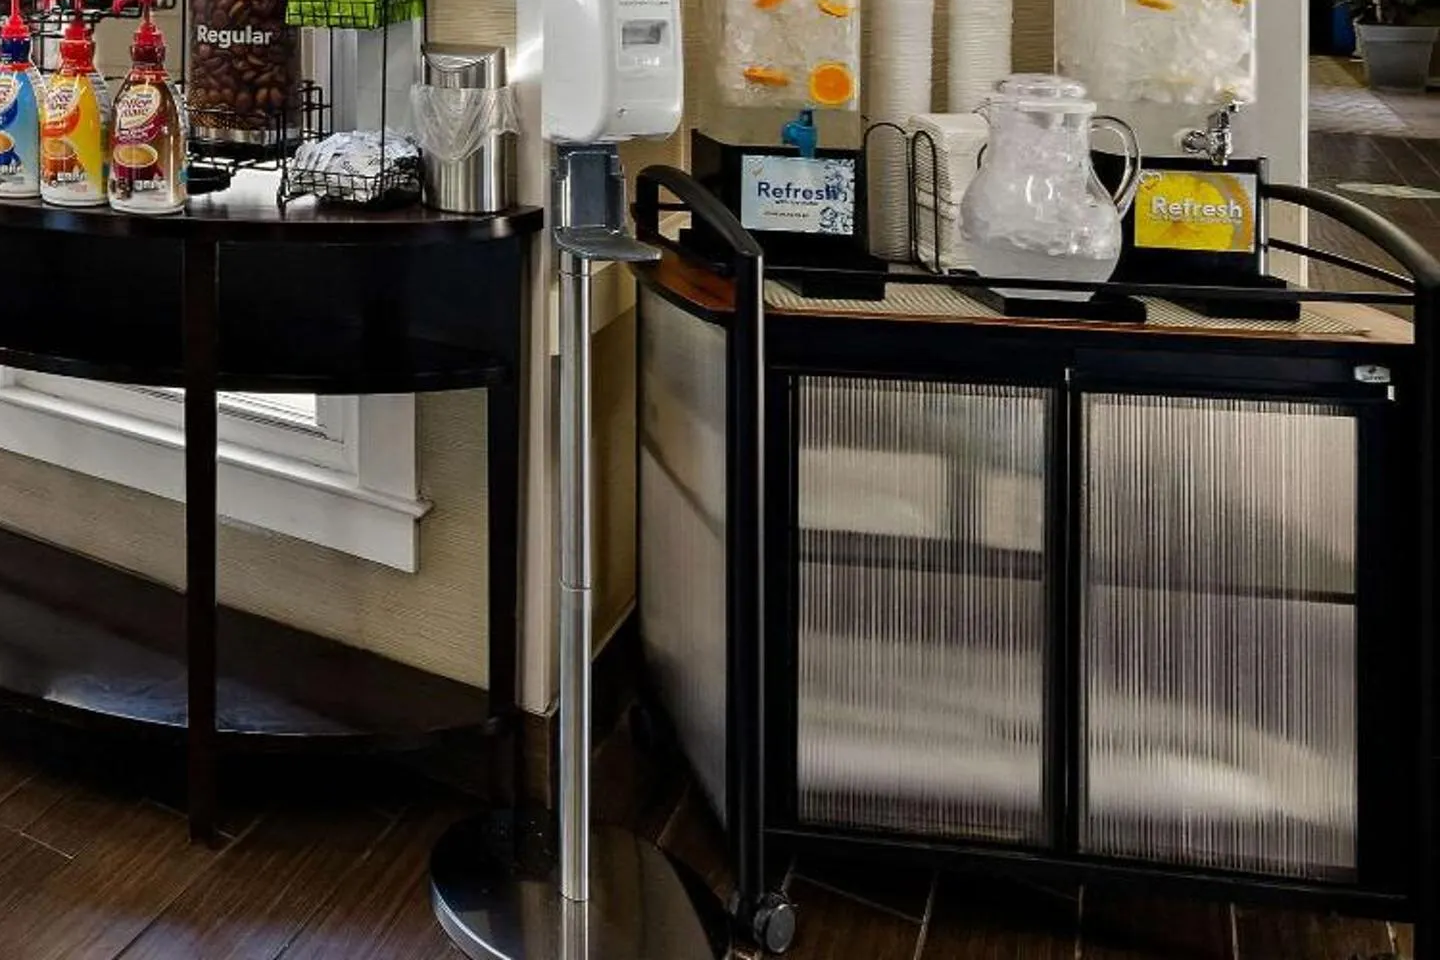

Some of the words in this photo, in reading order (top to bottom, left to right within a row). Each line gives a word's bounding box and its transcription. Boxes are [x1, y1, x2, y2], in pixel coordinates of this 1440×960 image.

[197, 24, 273, 49] Regular
[757, 181, 841, 201] Refresh
[1151, 196, 1243, 219] Refresh
